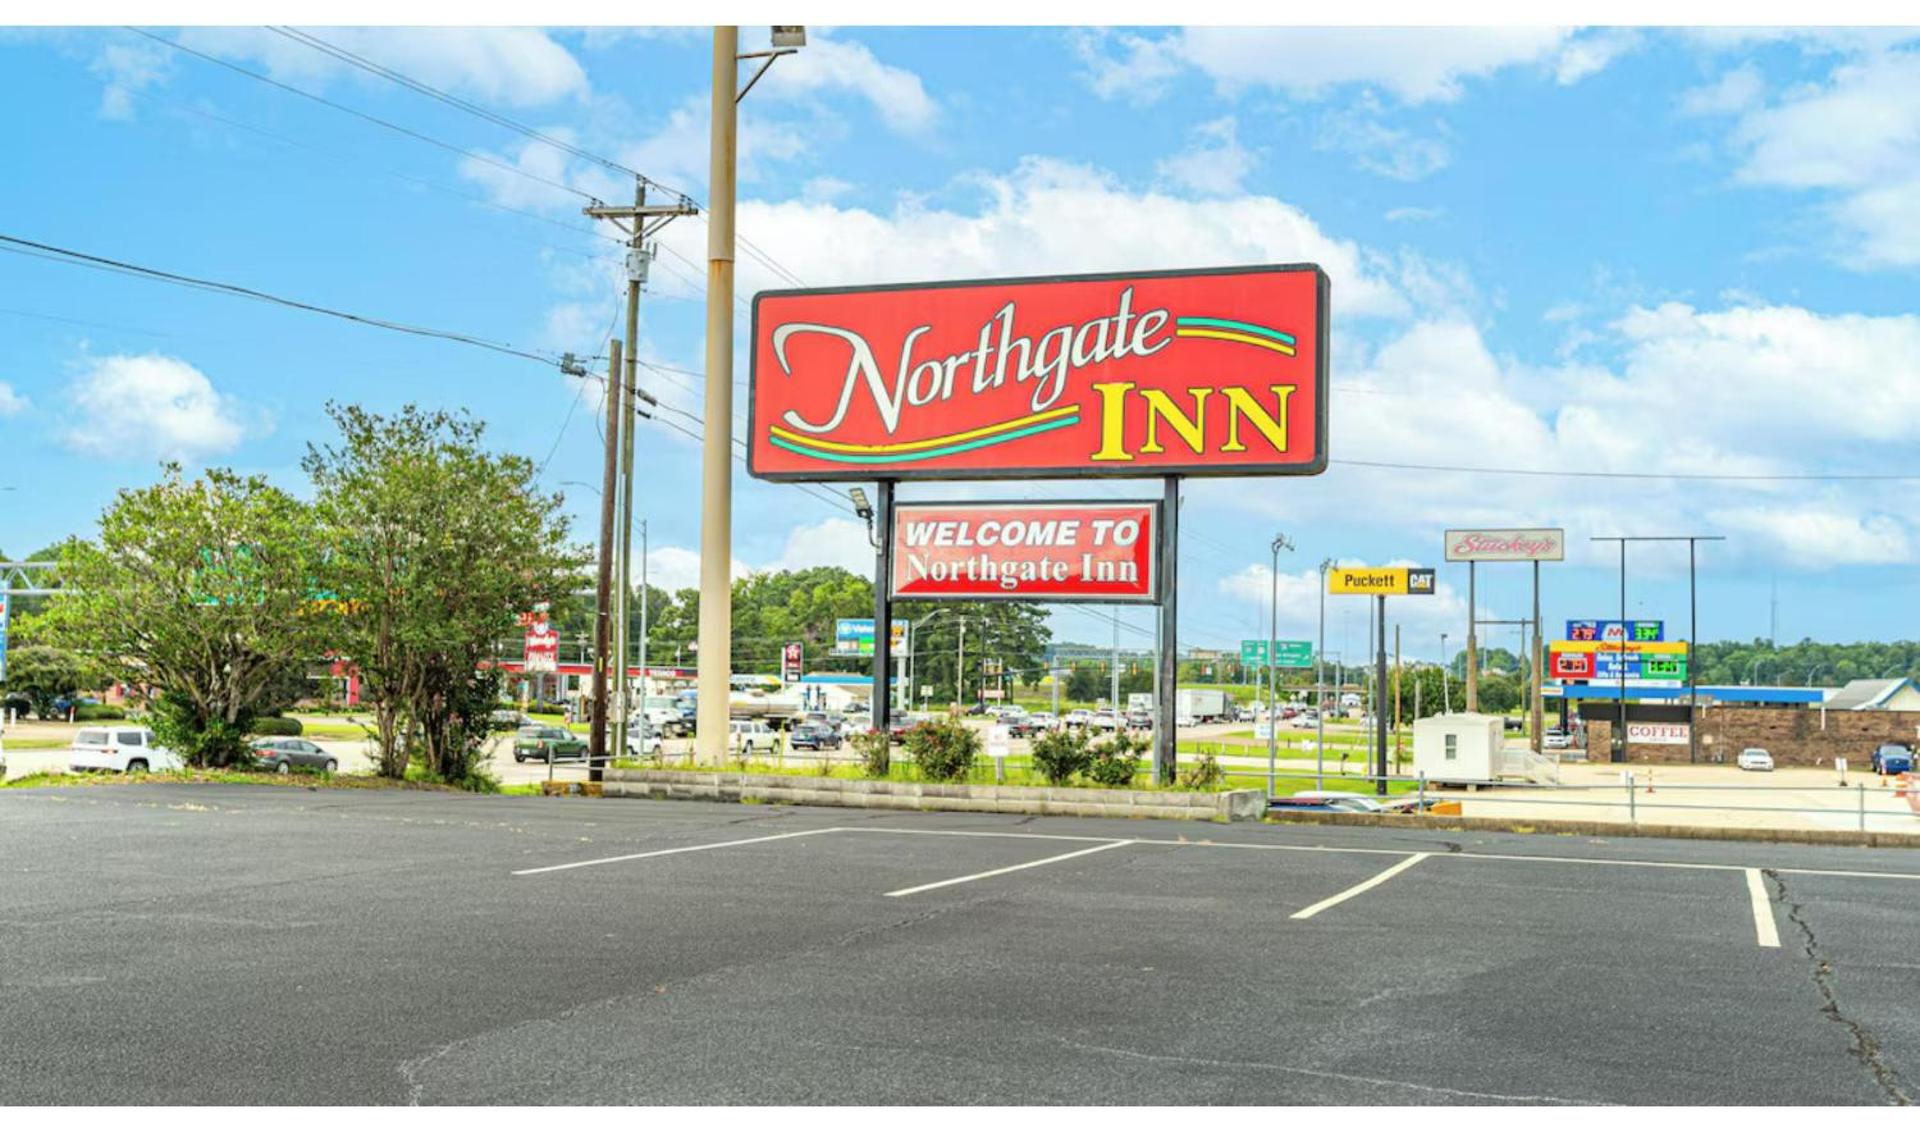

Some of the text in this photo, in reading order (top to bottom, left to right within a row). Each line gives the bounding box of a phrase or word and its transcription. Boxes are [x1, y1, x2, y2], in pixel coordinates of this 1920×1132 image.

[771, 286, 1172, 434] Northgate
[1090, 381, 1297, 461] INN
[905, 519, 1140, 547] WELCOME TO
[905, 552, 1138, 589] Northgate Inn
[1344, 574, 1432, 588] Puckett CAT
[1629, 726, 1688, 738] COFFEE
